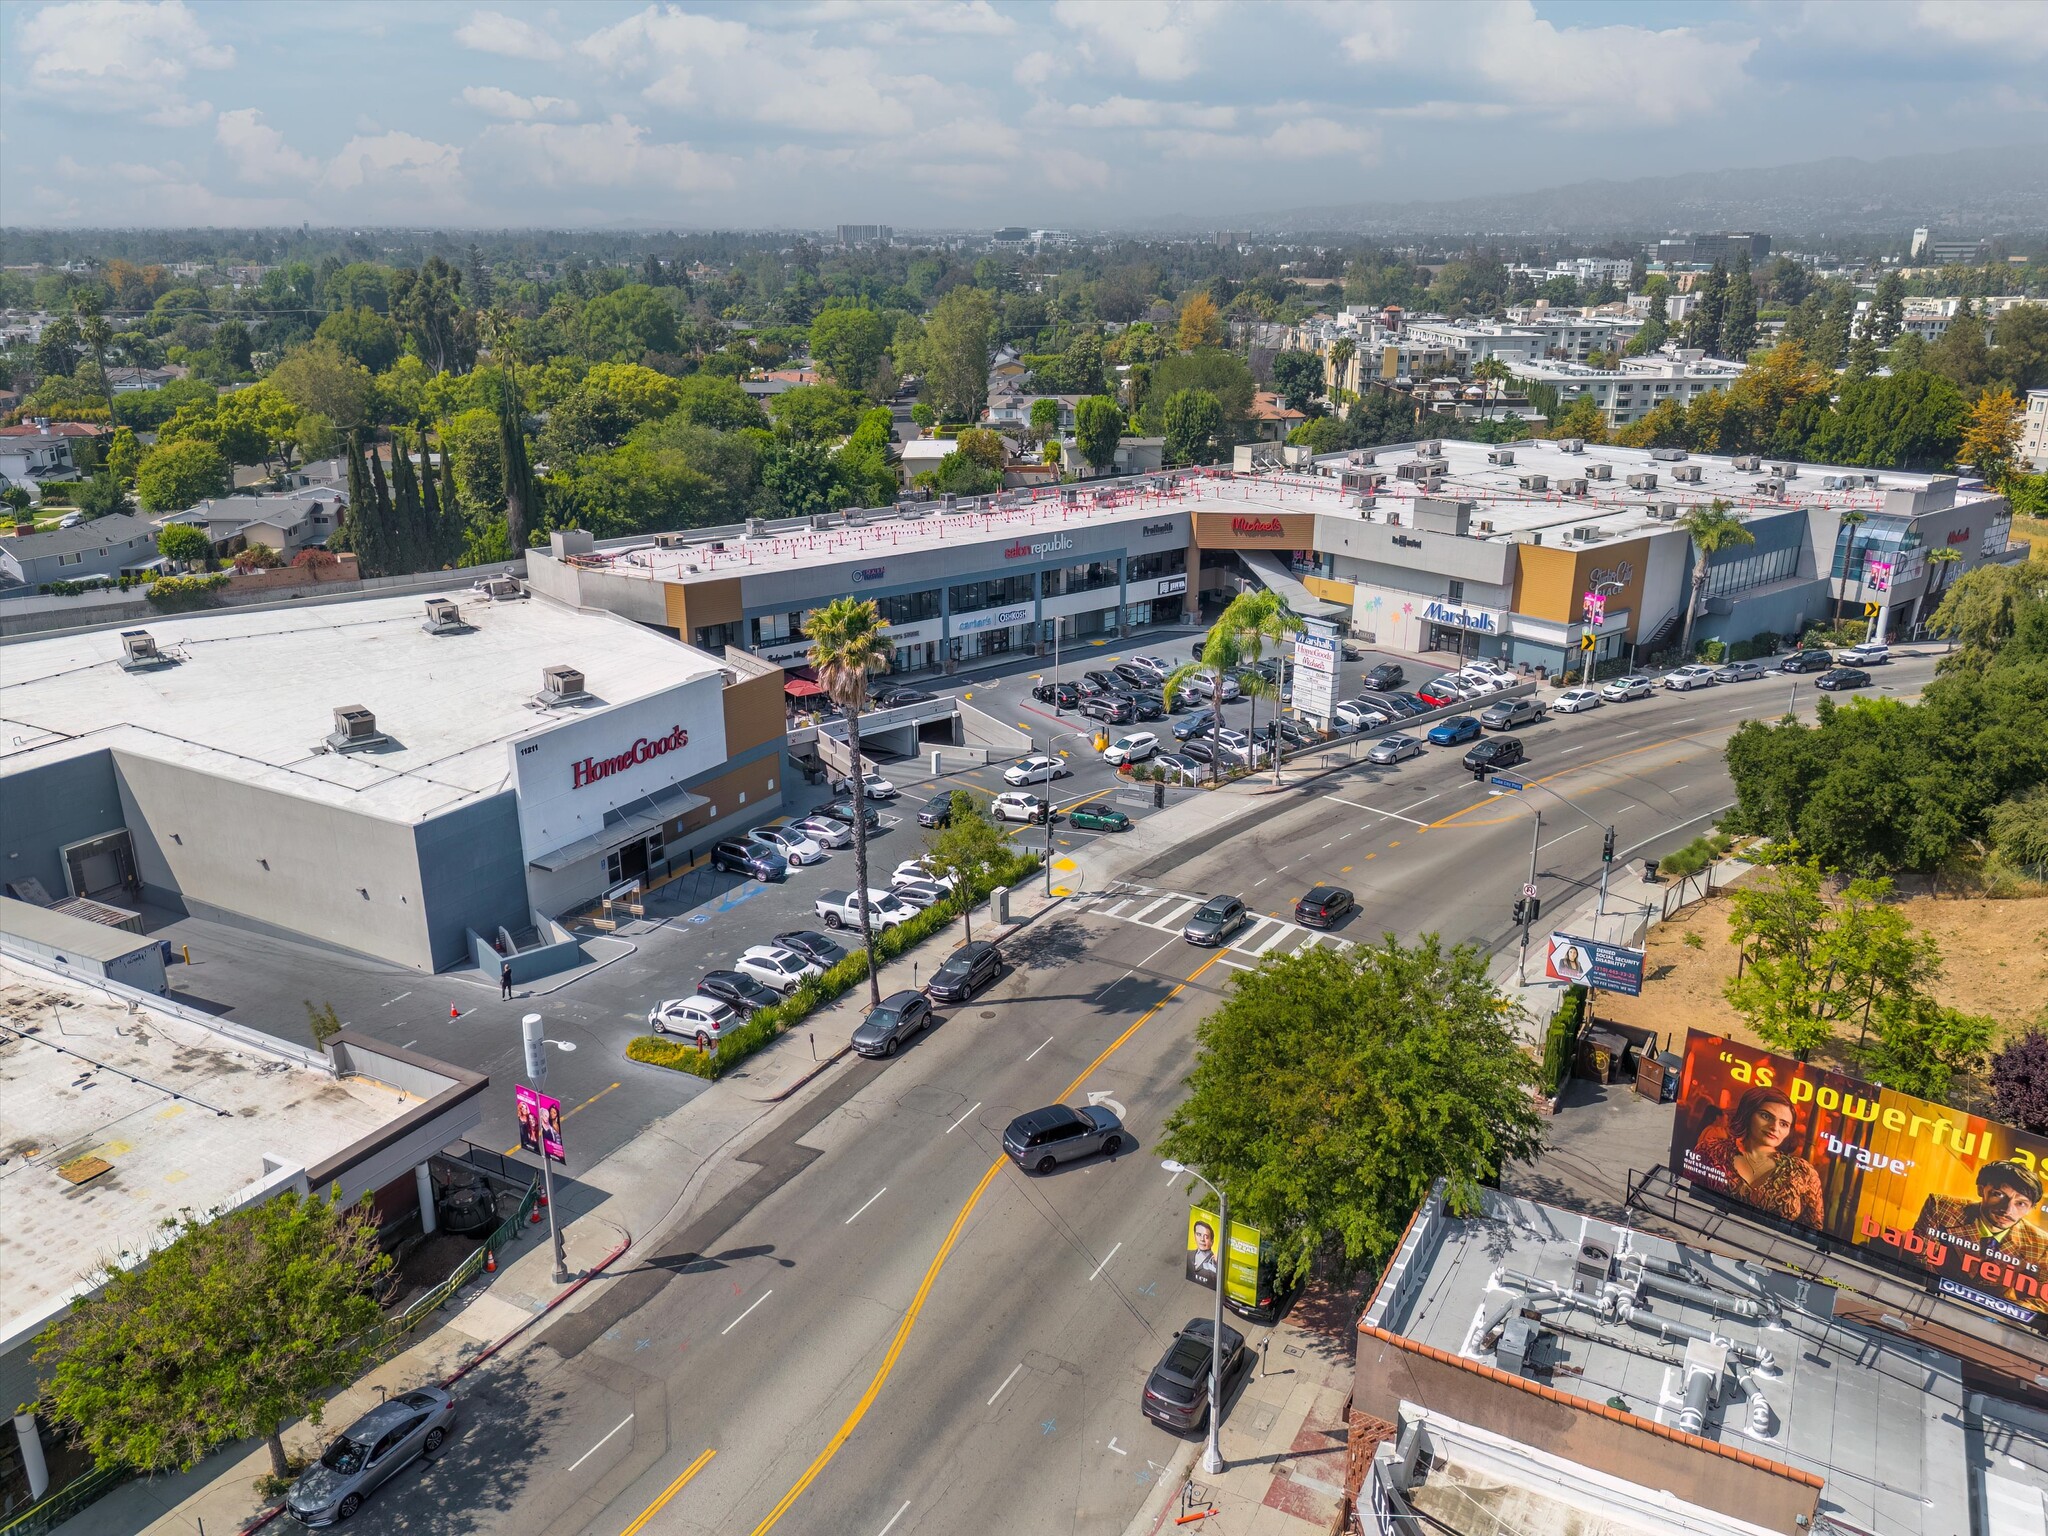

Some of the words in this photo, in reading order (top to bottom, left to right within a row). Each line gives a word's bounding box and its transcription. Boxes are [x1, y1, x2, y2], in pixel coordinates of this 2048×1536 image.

[1423, 602, 1496, 631] Marshalls
[520, 744, 539, 756] 11211
[571, 724, 689, 790] HomeGoods
[1596, 948, 1615, 956] DENIED
[1596, 953, 1615, 961] SOCIAL
[1615, 956, 1640, 965] SECURITY
[1789, 1077, 1993, 1161] powerful
[1683, 1157, 1726, 1177] outstanding
[1683, 1163, 1707, 1176] limited
[1707, 1173, 1728, 1184] series
[1861, 1215, 1947, 1266] baby
[1928, 1227, 1980, 1252] RICHARD
[1986, 1248, 2020, 1266] GADD
[2026, 1262, 2038, 1272] IS
[1943, 1280, 2031, 1320] OUTFRONT
